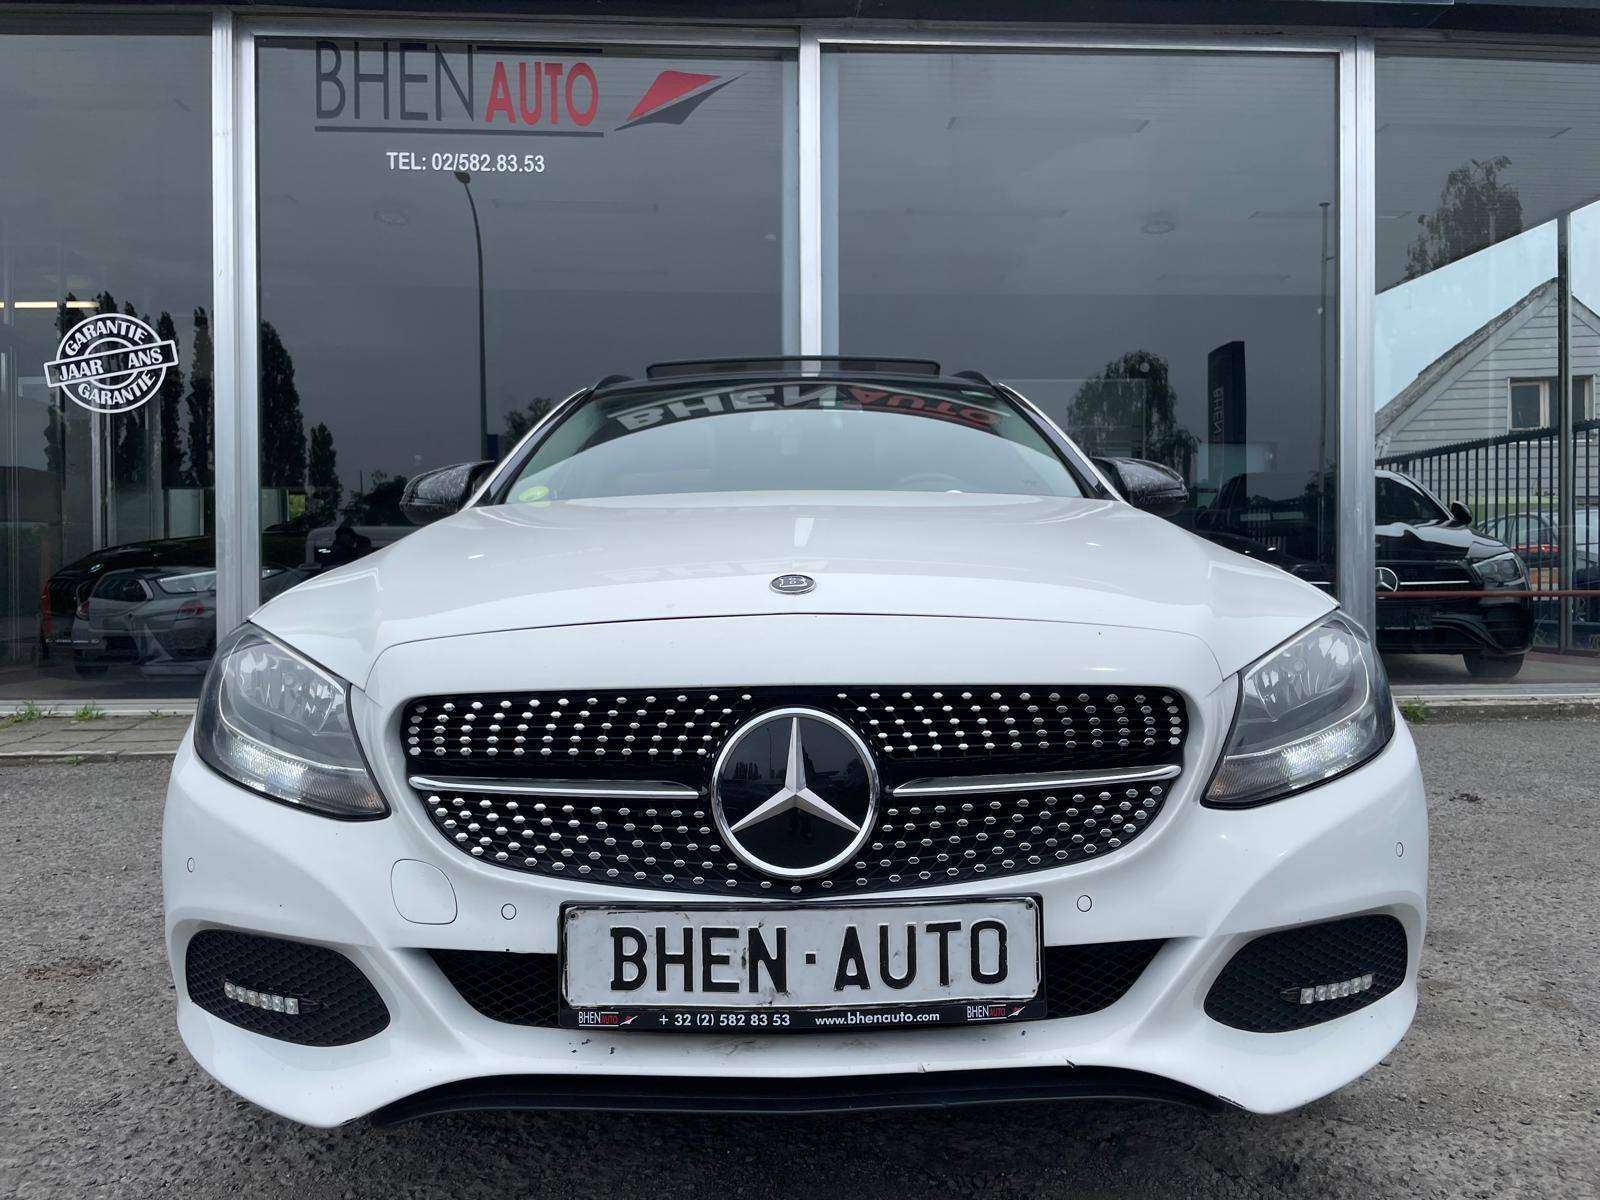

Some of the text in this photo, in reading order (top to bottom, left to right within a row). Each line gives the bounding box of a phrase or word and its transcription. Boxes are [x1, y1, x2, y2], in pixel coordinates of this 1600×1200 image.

[315, 40, 599, 126] BHEN AUTO
[386, 152, 545, 172] TEL: 02/582.83.53
[65, 320, 147, 356] GARANTIE
[59, 348, 163, 381] JAAR ANS
[77, 370, 156, 405] GARANTIE
[610, 926, 787, 993] BHEN
[833, 920, 1008, 991] AUTO
[578, 1011, 601, 1024] BHEN
[674, 1014, 692, 1026] 32
[696, 1013, 714, 1026] (2)
[720, 1014, 746, 1026] 582
[750, 1014, 768, 1026] 83
[772, 1014, 791, 1026] 53
[815, 1011, 940, 1026] www.bhenauto.com
[966, 1005, 990, 1018] BHEN
